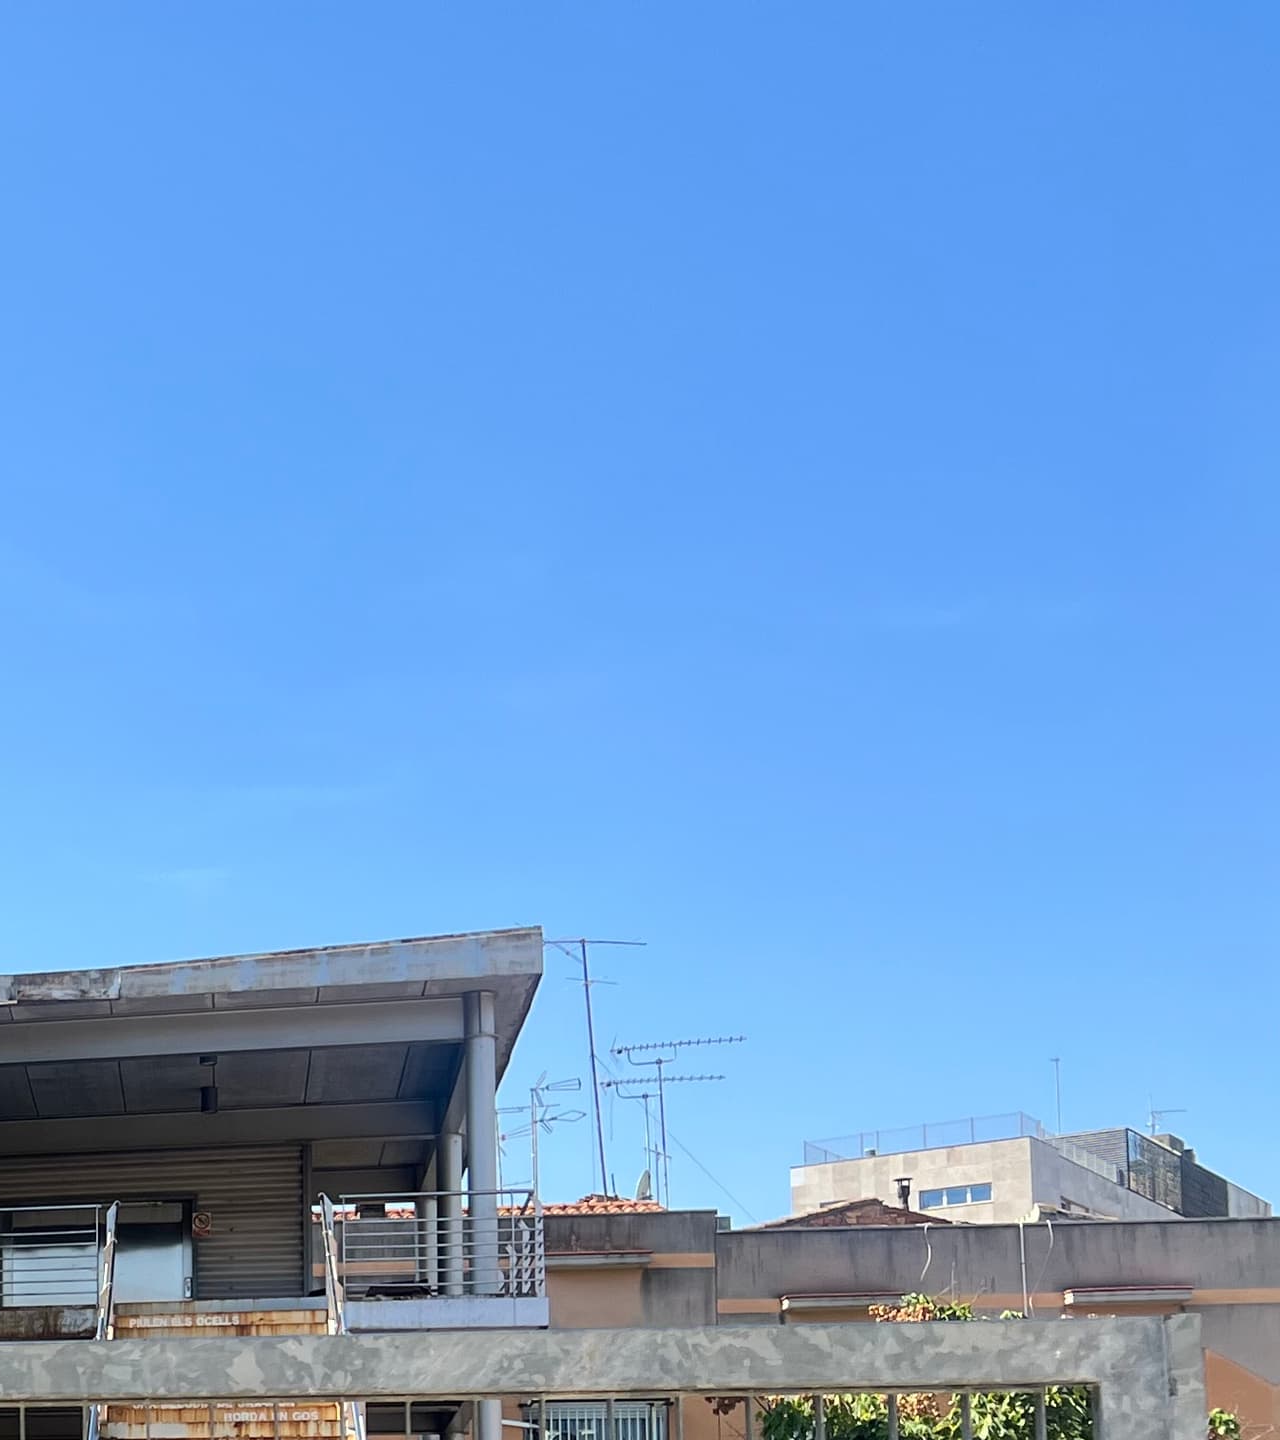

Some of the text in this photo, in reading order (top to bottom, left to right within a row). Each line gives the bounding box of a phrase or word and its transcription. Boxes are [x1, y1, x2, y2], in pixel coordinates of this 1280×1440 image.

[196, 1314, 240, 1326] OCELLS
[224, 1411, 267, 1422] BORDA
[292, 1410, 319, 1421] GOS
